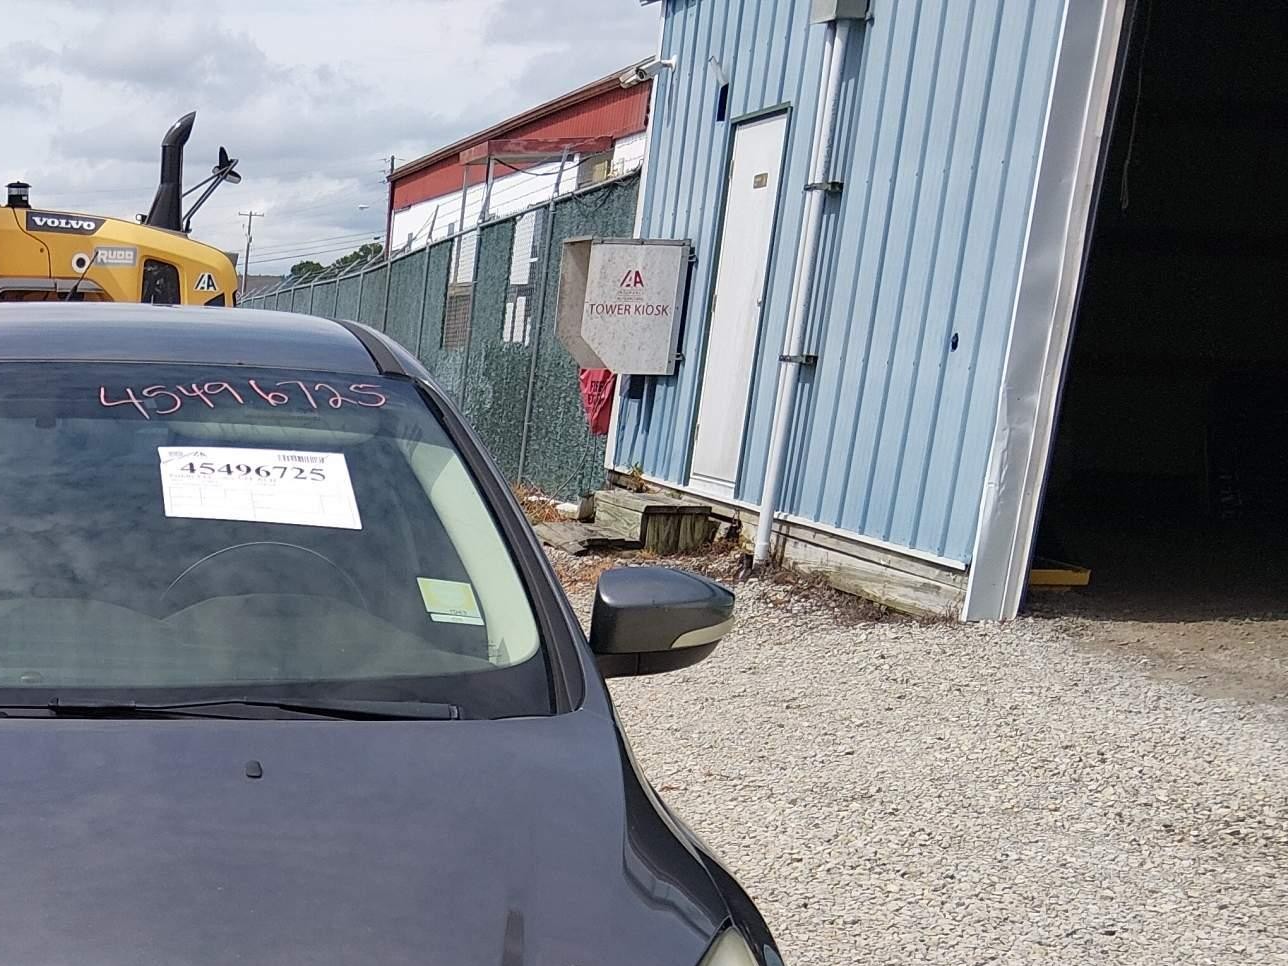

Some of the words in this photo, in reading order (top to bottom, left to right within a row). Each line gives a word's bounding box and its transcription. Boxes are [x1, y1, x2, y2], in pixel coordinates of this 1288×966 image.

[32, 216, 96, 230] VOLVO
[589, 303, 631, 316] TOWER
[634, 304, 670, 316] KIOSK
[100, 379, 386, 420] 45496725
[179, 461, 326, 481] 45496725
